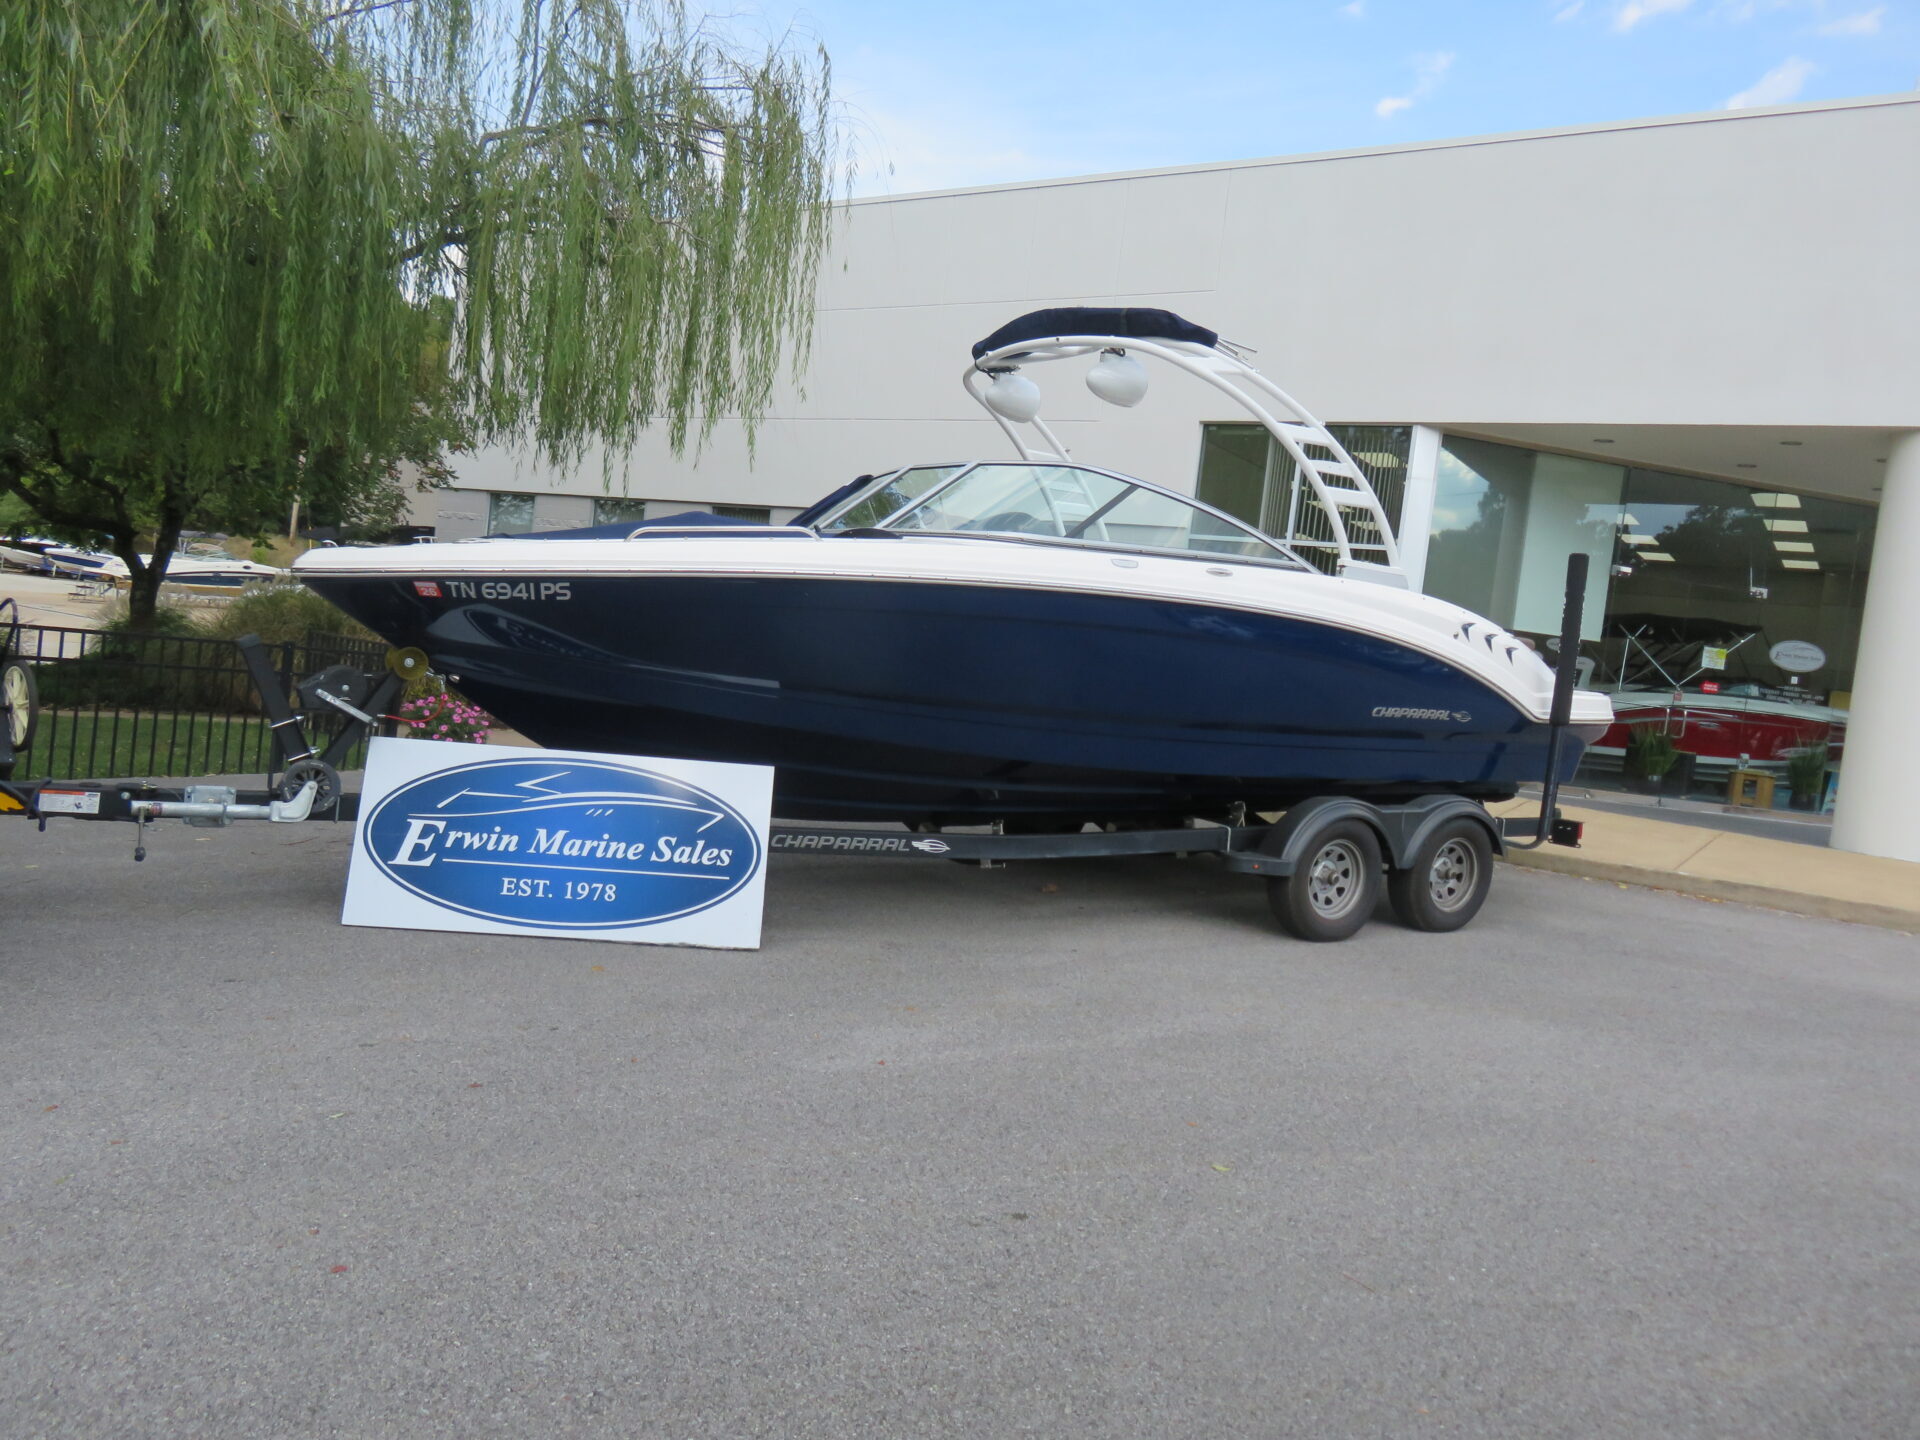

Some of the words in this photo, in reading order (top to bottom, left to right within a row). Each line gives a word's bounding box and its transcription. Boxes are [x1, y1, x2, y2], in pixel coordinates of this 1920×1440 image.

[419, 587, 438, 597] 26
[445, 581, 477, 599] TN
[481, 582, 536, 600] 6941
[540, 582, 572, 600] PS
[1371, 706, 1451, 721] CHAPARRAL
[387, 818, 520, 867] Erwin
[526, 828, 645, 861] Marine
[650, 835, 733, 867] Sales
[770, 834, 910, 852] CHAPARRAL
[500, 877, 553, 899] EST.
[564, 881, 617, 902] 1978
